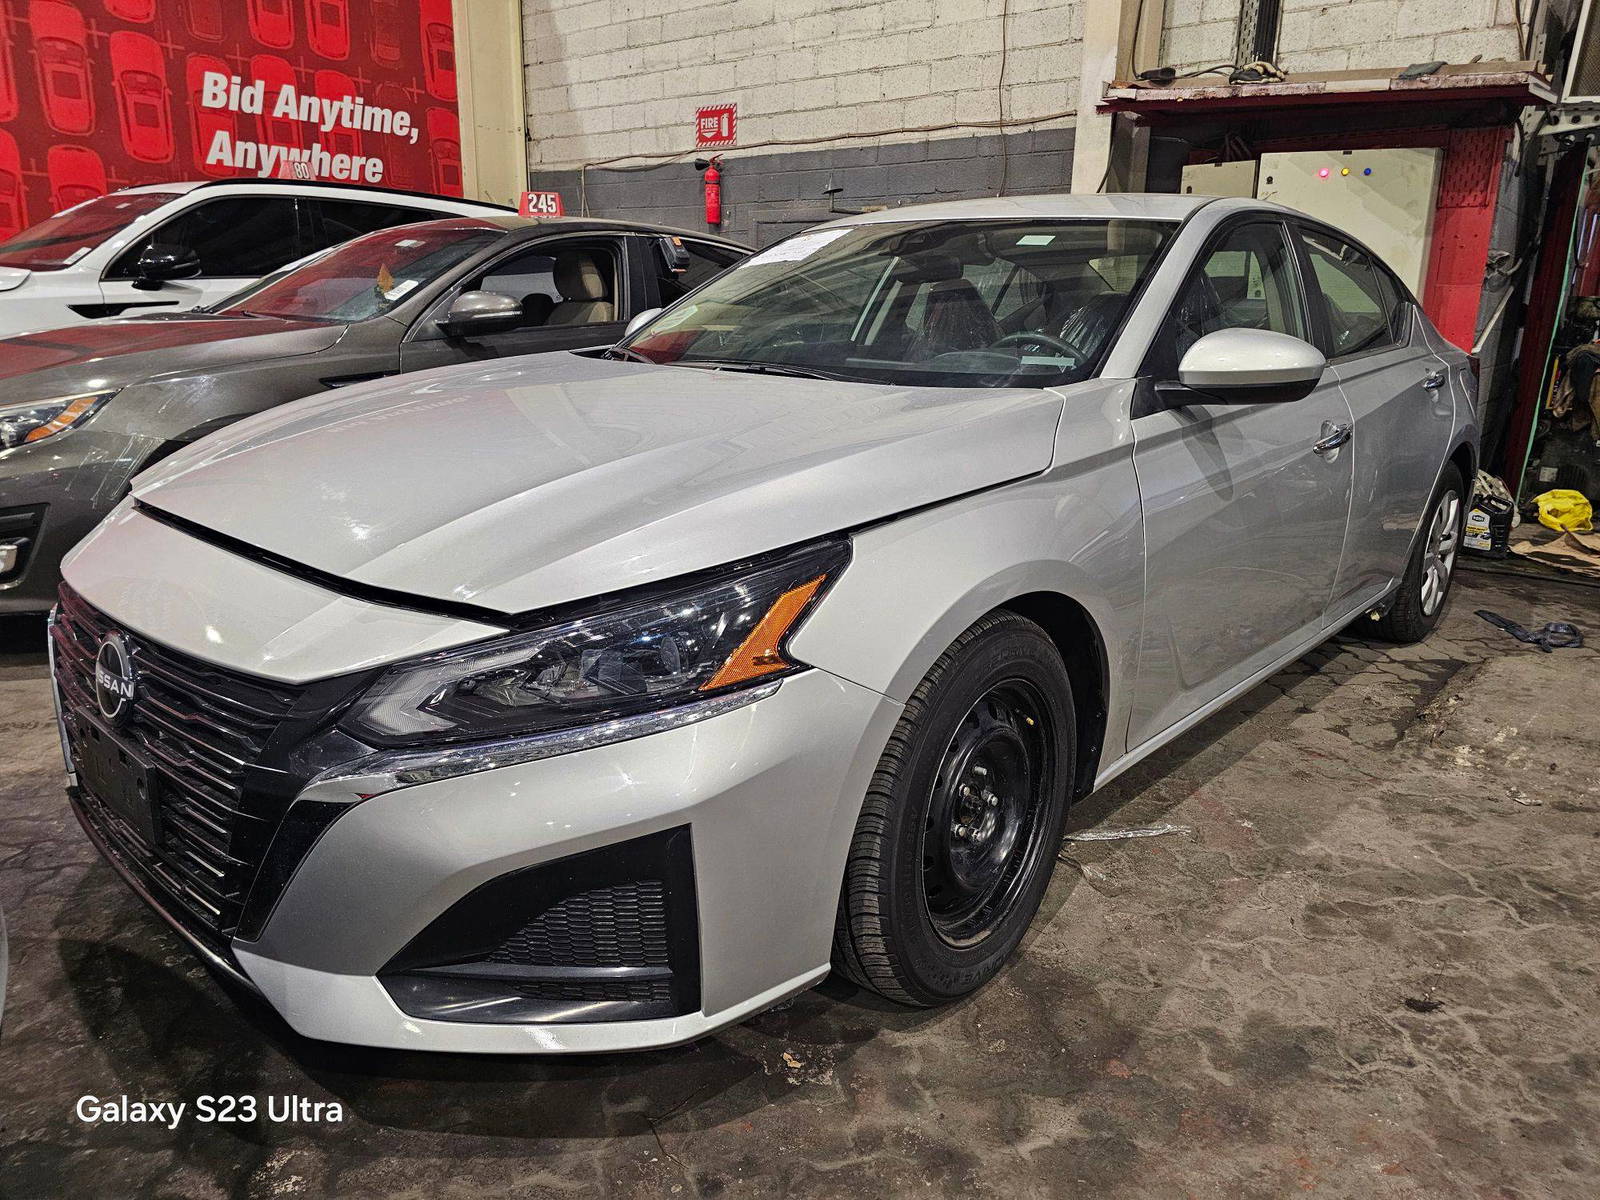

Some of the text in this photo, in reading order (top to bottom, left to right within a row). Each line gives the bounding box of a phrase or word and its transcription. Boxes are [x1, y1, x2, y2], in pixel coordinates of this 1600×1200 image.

[201, 71, 419, 145] Bid Anytime,
[700, 116, 719, 129] FIRE
[206, 130, 384, 183] Anywhere
[527, 193, 557, 213] 245
